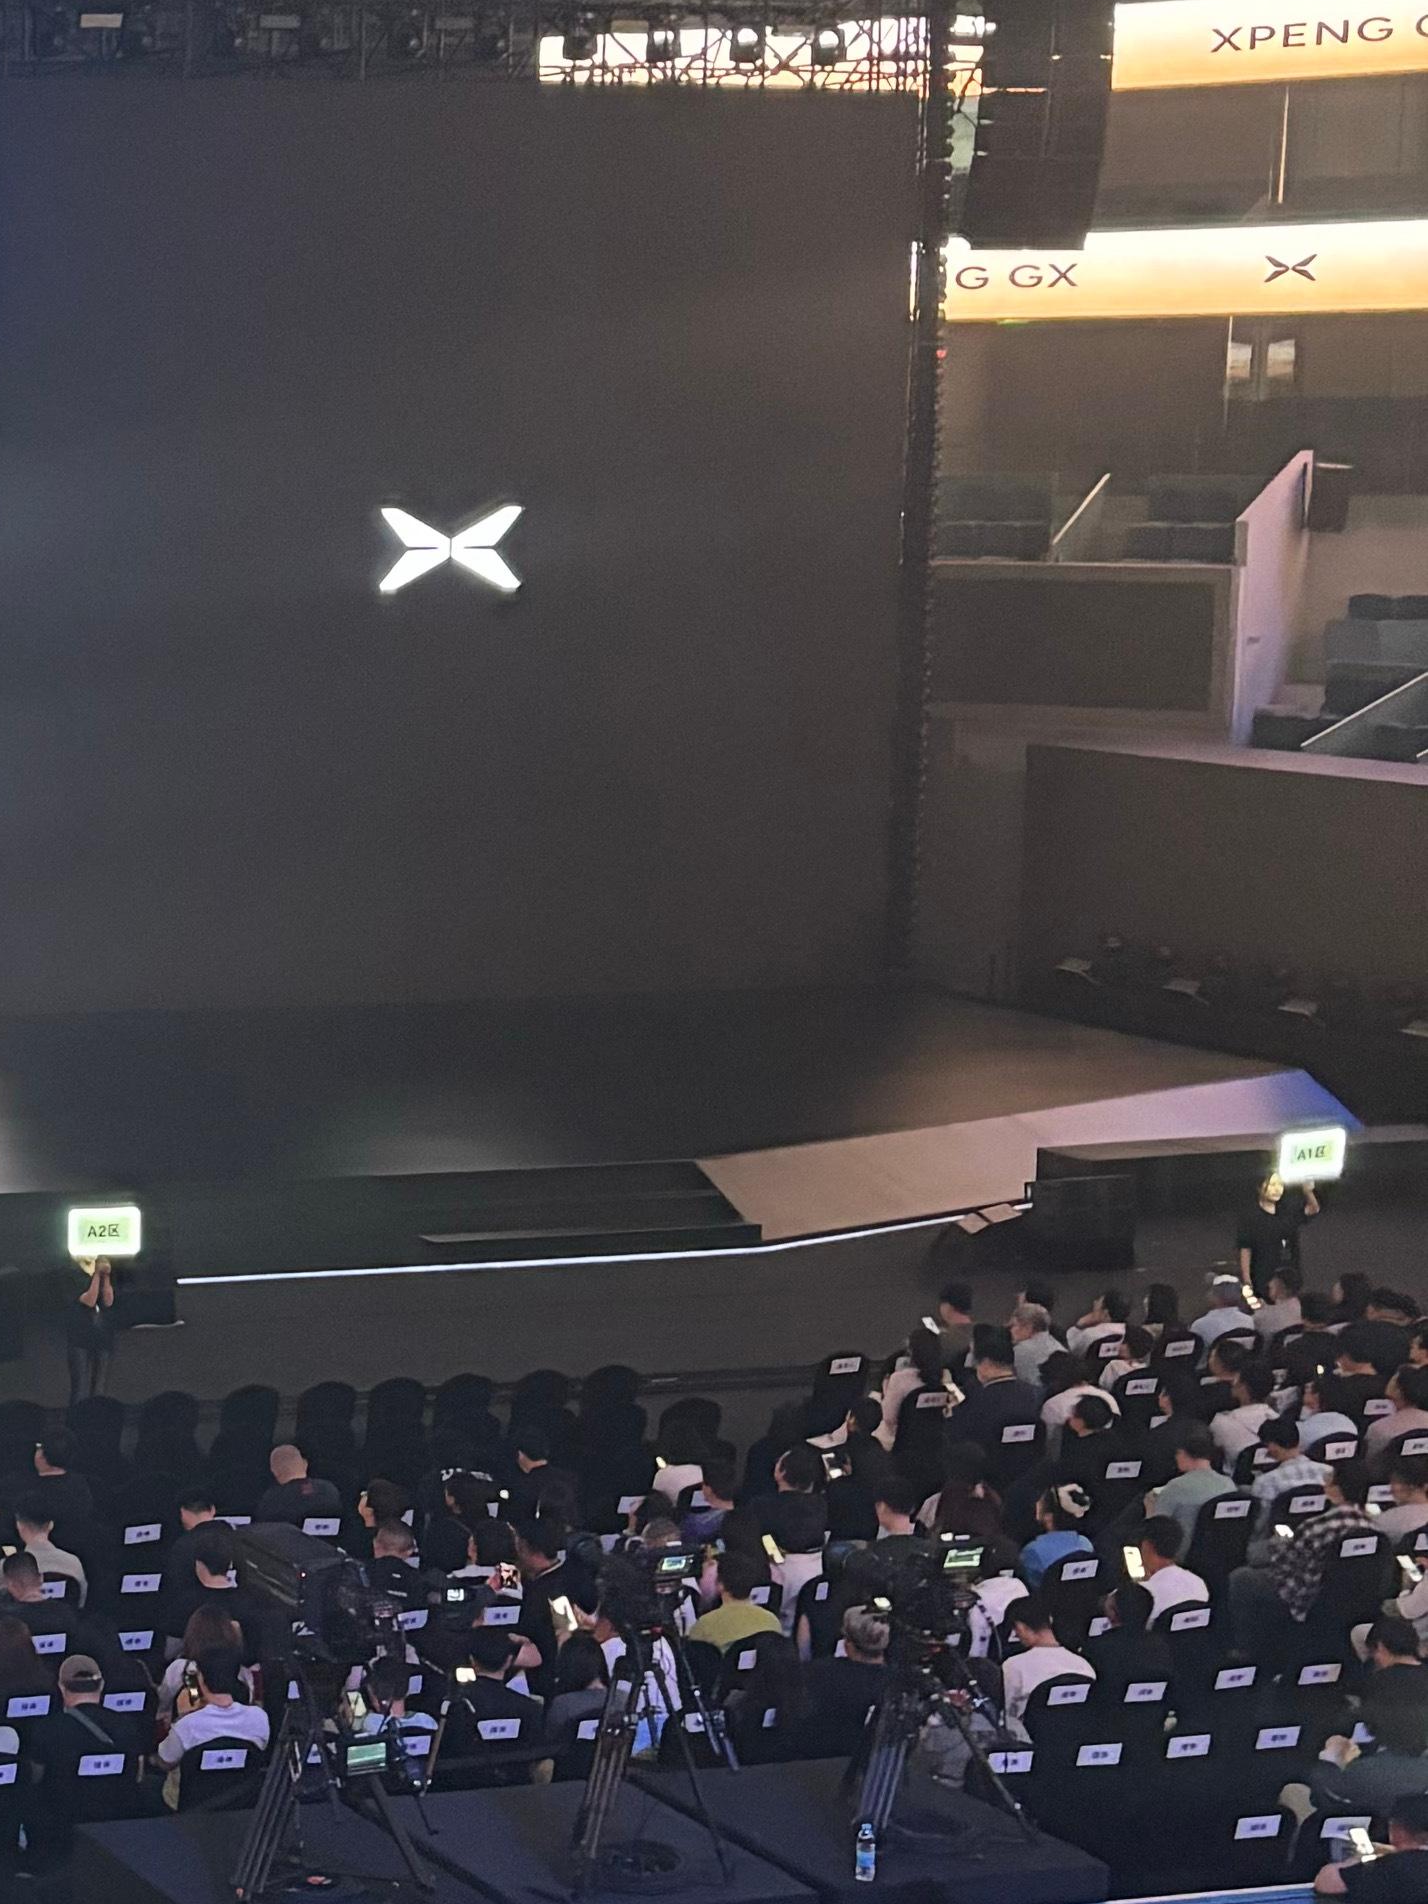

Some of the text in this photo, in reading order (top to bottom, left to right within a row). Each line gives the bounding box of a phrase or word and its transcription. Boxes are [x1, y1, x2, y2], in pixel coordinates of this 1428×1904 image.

[1211, 17, 1394, 53] XPENG
[1009, 264, 1078, 288] GX
[88, 1224, 119, 1237] A2区
